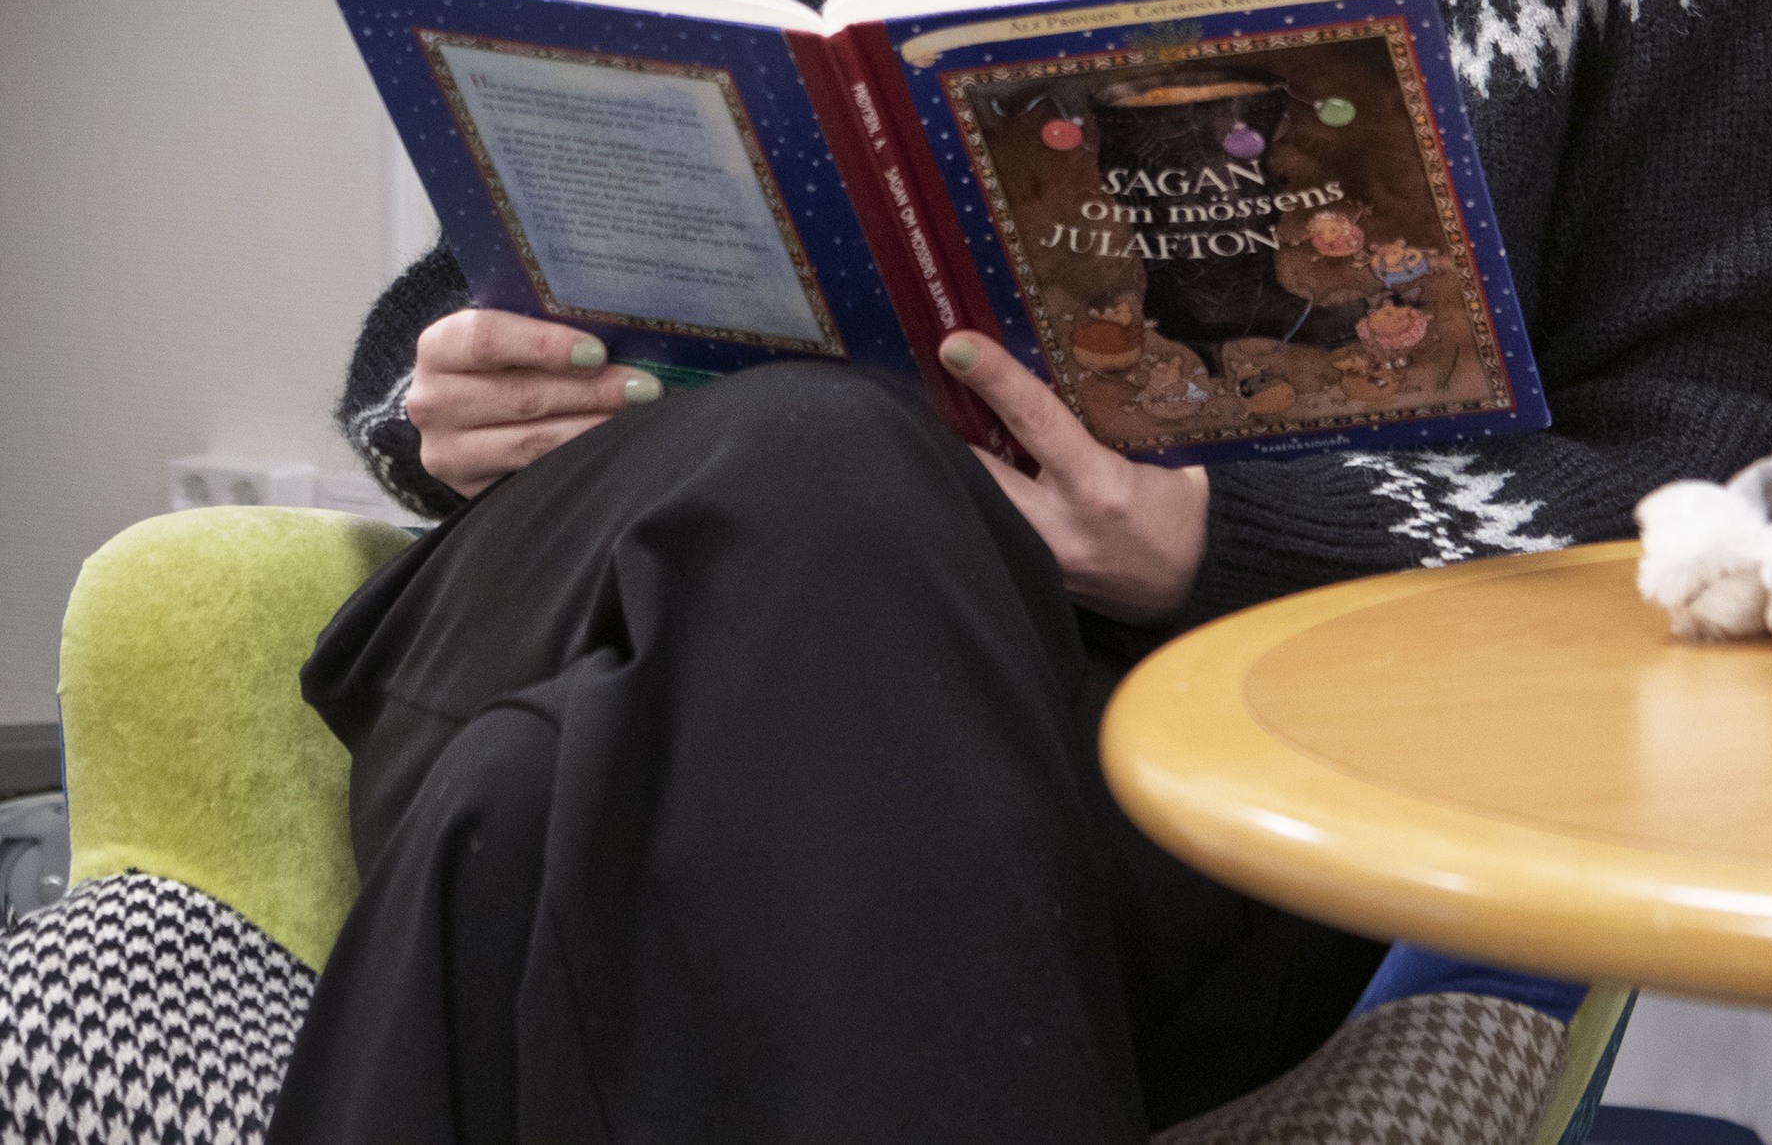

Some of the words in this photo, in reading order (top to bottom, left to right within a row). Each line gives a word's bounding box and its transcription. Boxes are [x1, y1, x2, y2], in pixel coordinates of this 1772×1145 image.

[884, 165, 910, 207] SAGAN
[1100, 159, 1267, 197] SAGAN
[1081, 200, 1154, 224] om
[1168, 181, 1345, 224] mössens
[1039, 222, 1281, 260] JULAFTON
